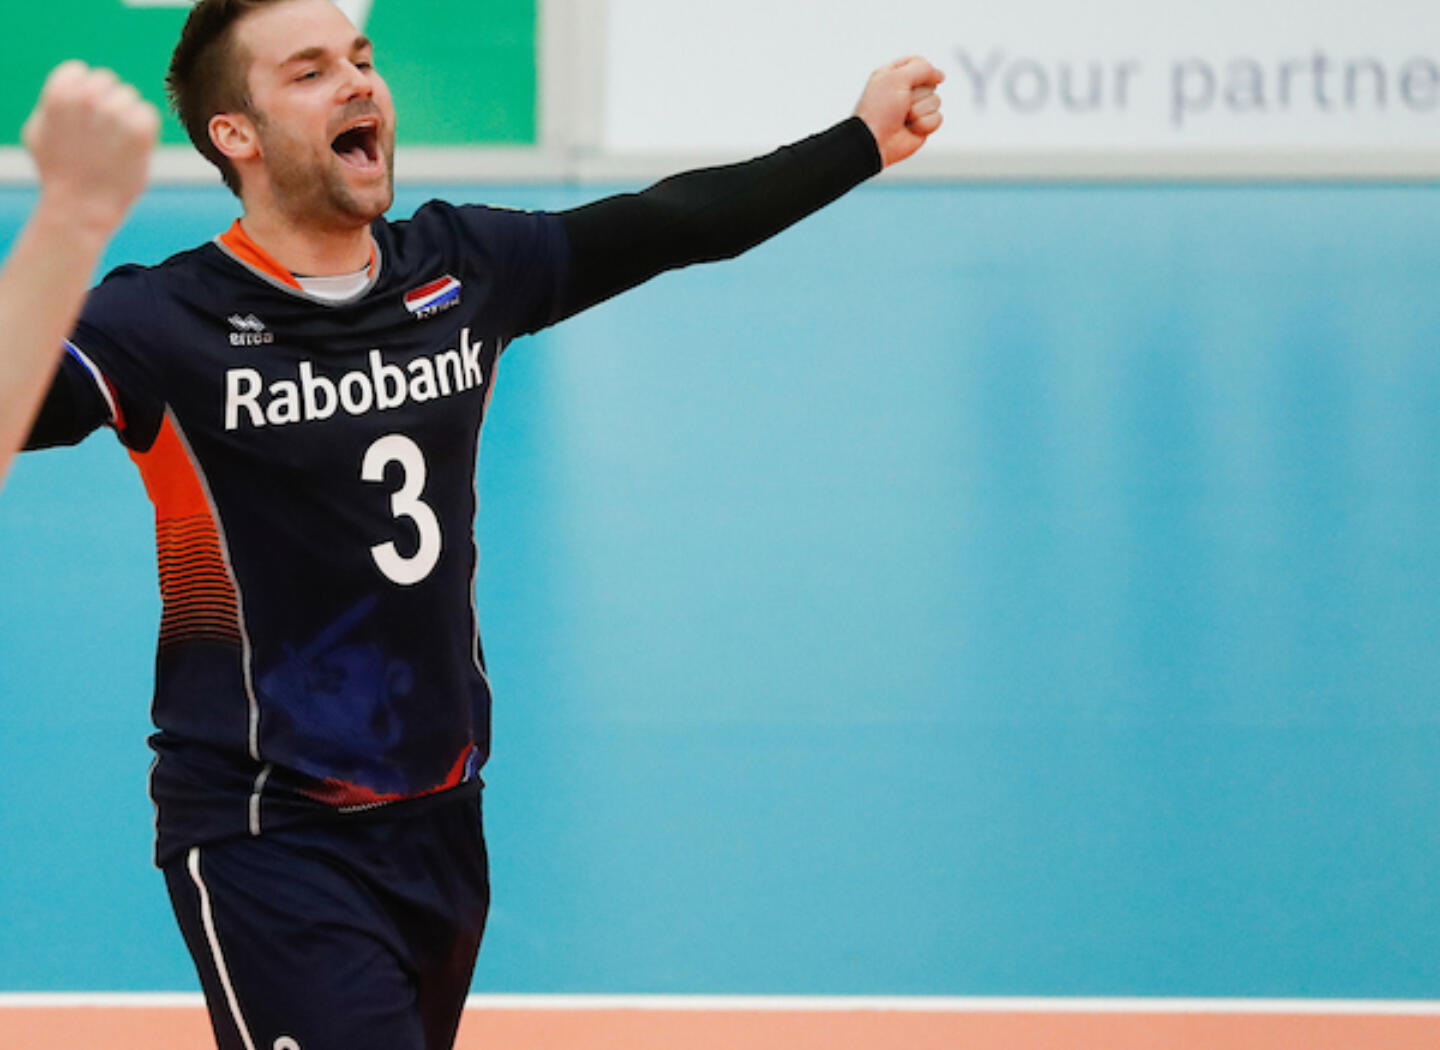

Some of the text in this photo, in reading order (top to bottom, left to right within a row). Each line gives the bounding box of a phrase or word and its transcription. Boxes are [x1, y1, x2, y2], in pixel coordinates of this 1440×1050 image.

[957, 47, 1440, 128] Your partne
[225, 328, 482, 430] Rabobank
[361, 433, 442, 586] 3
